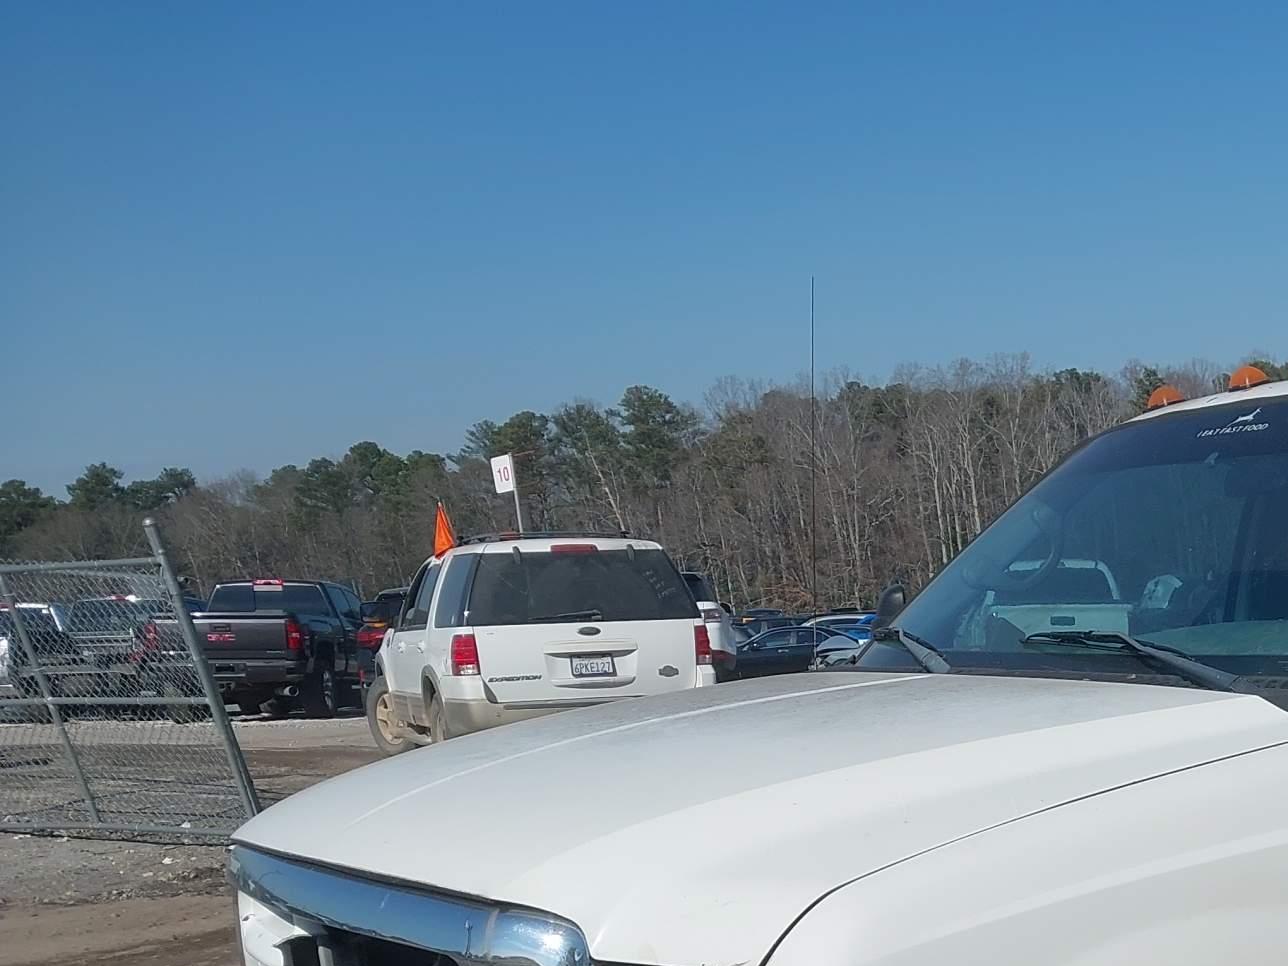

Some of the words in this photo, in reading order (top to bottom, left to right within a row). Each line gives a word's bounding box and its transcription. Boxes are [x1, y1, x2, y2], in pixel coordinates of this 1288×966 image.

[1201, 428, 1221, 437] EAT
[1219, 424, 1244, 434] FAST
[1241, 423, 1269, 432] FOOD
[496, 466, 510, 482] 10
[574, 661, 611, 674] 6PKE127
[487, 674, 542, 683] EXPEDITION
